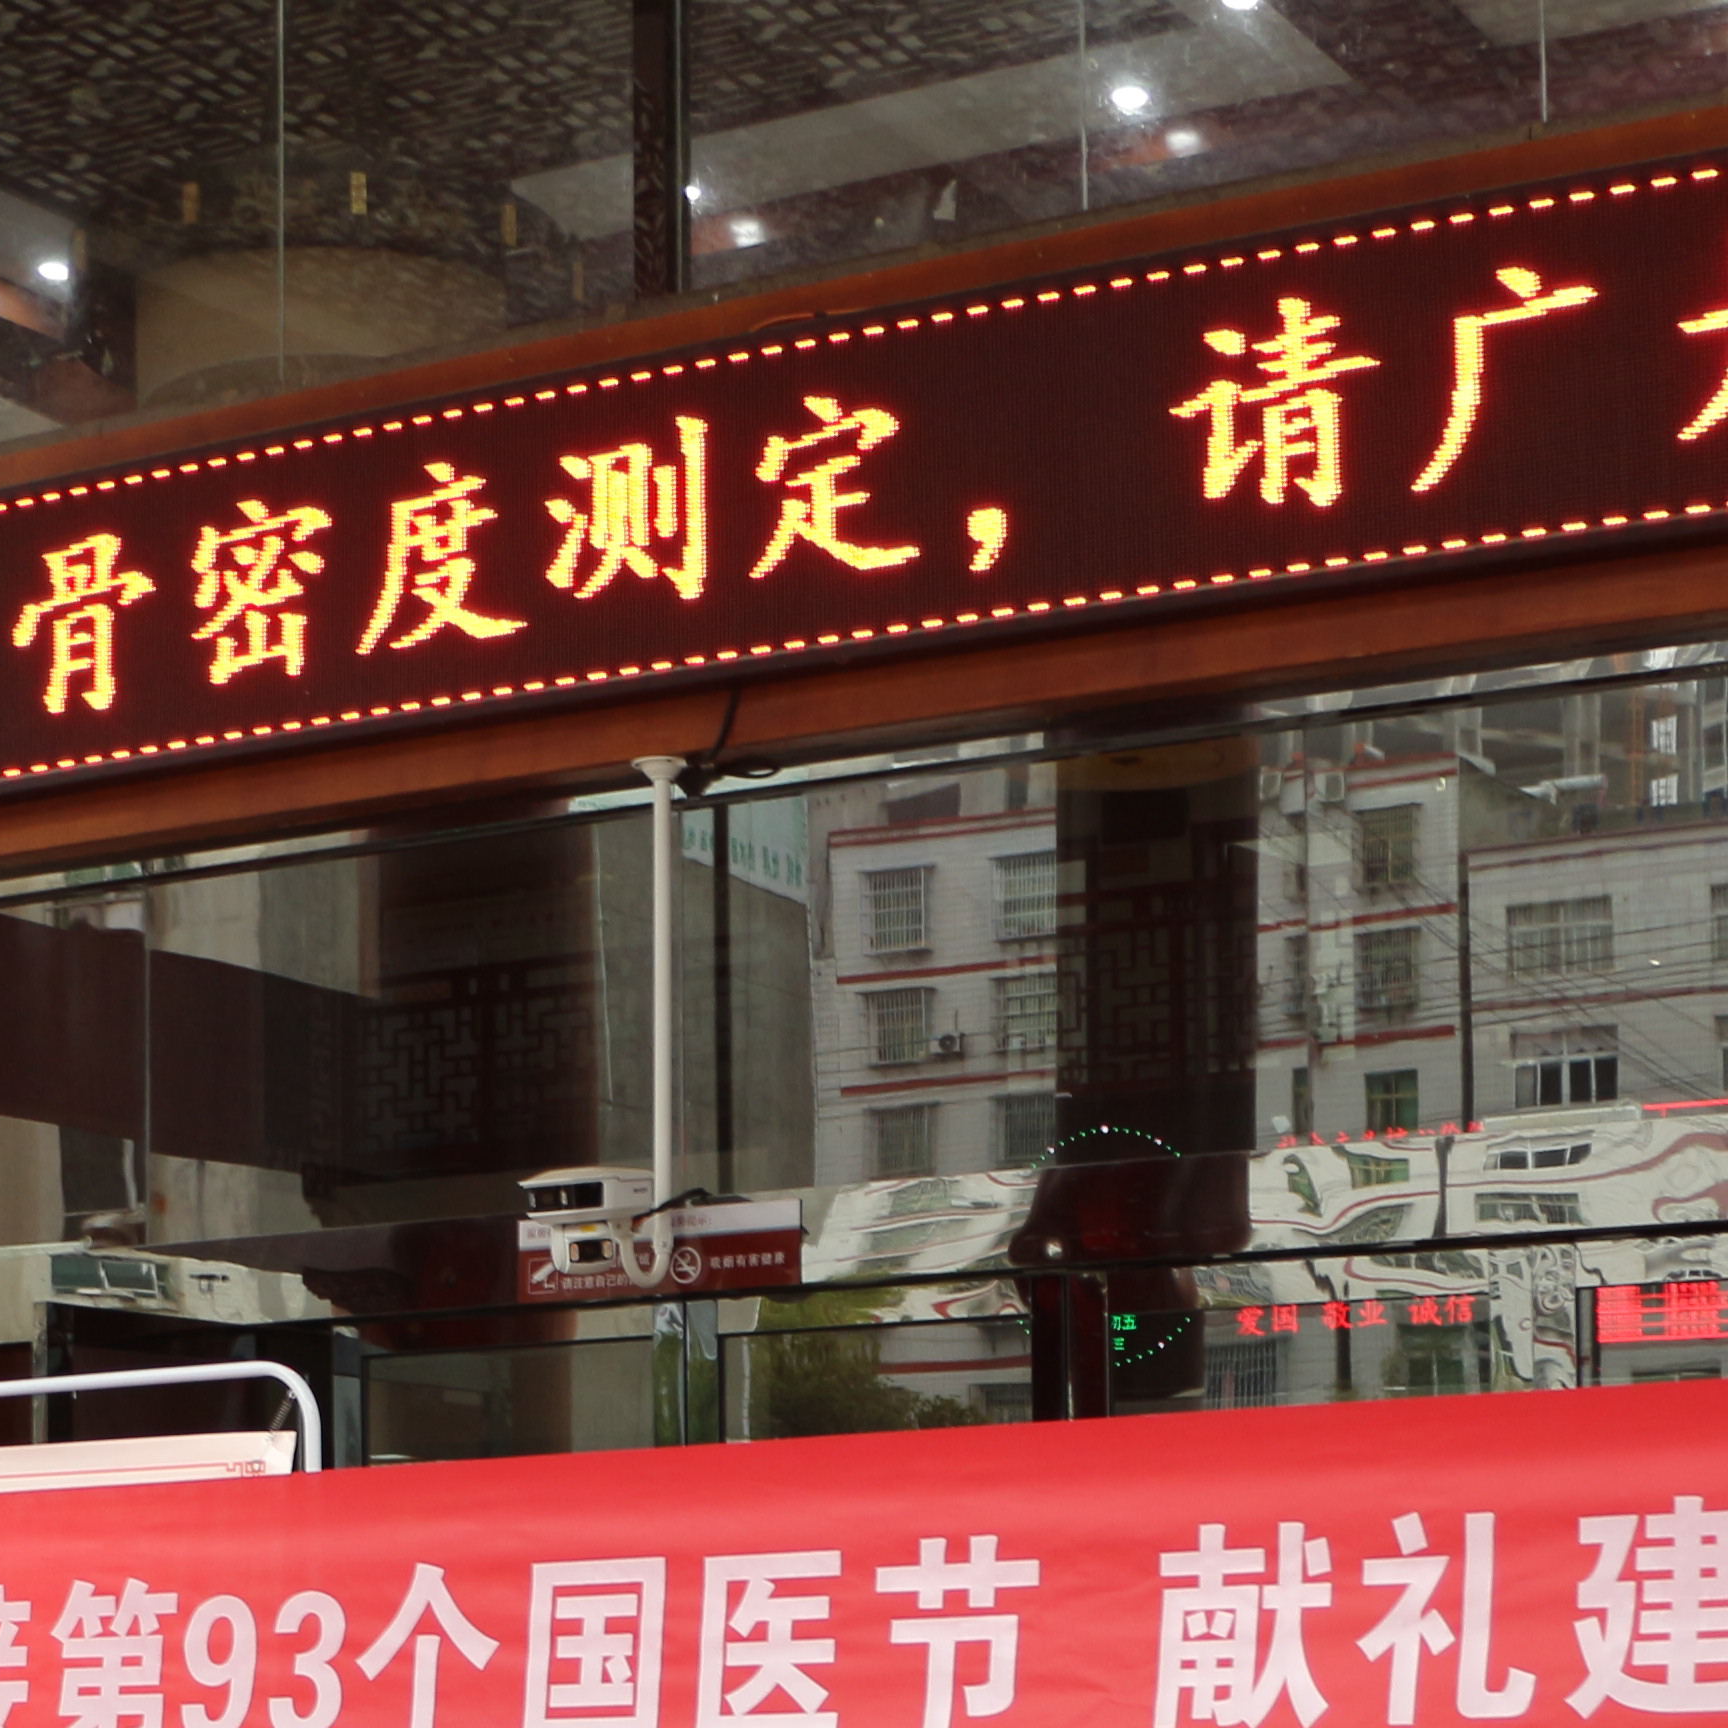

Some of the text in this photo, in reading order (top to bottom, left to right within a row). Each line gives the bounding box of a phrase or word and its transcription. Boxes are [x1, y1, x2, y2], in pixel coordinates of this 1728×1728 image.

[1235, 1294, 1477, 1337] 爱国 敬业 诚信
